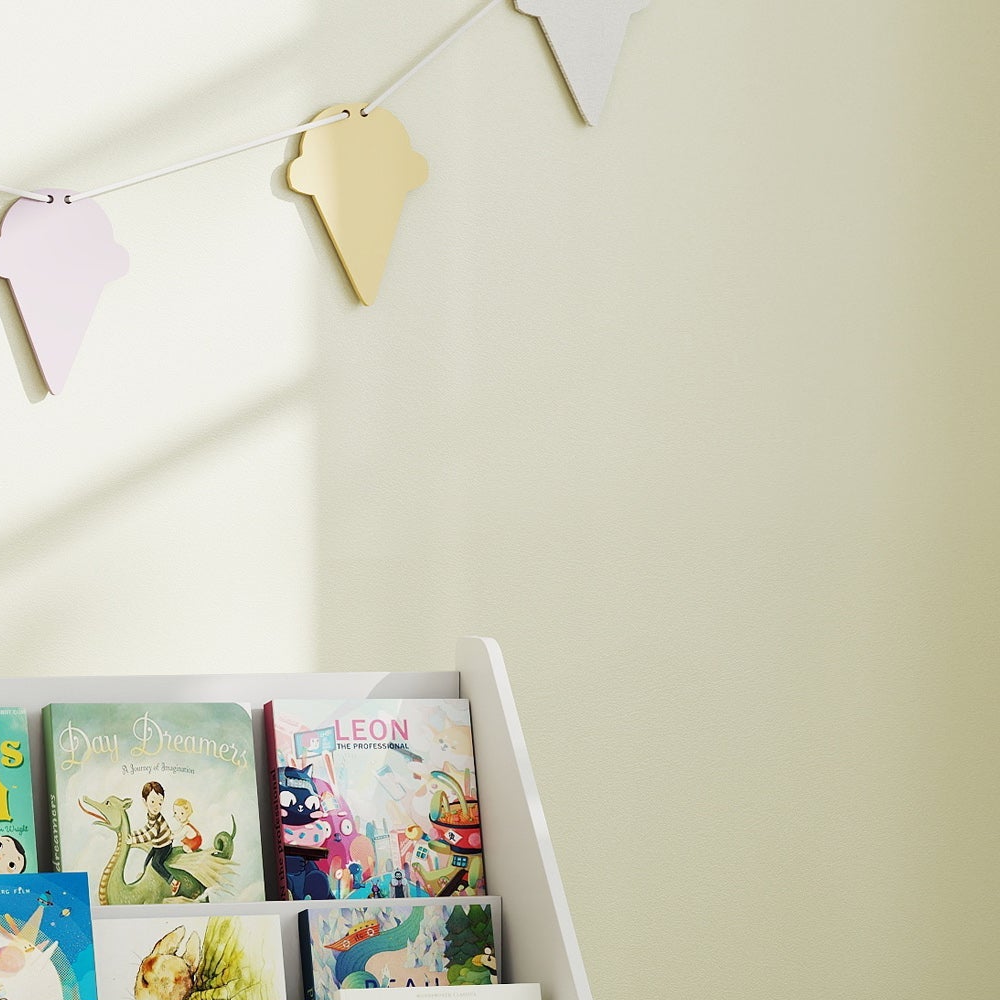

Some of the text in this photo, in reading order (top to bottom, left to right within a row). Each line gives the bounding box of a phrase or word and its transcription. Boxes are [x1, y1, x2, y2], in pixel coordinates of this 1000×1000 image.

[335, 719, 409, 740] LEON
[59, 712, 248, 771] Day Dreamers
[353, 742, 410, 750] PROFESSIONAL
